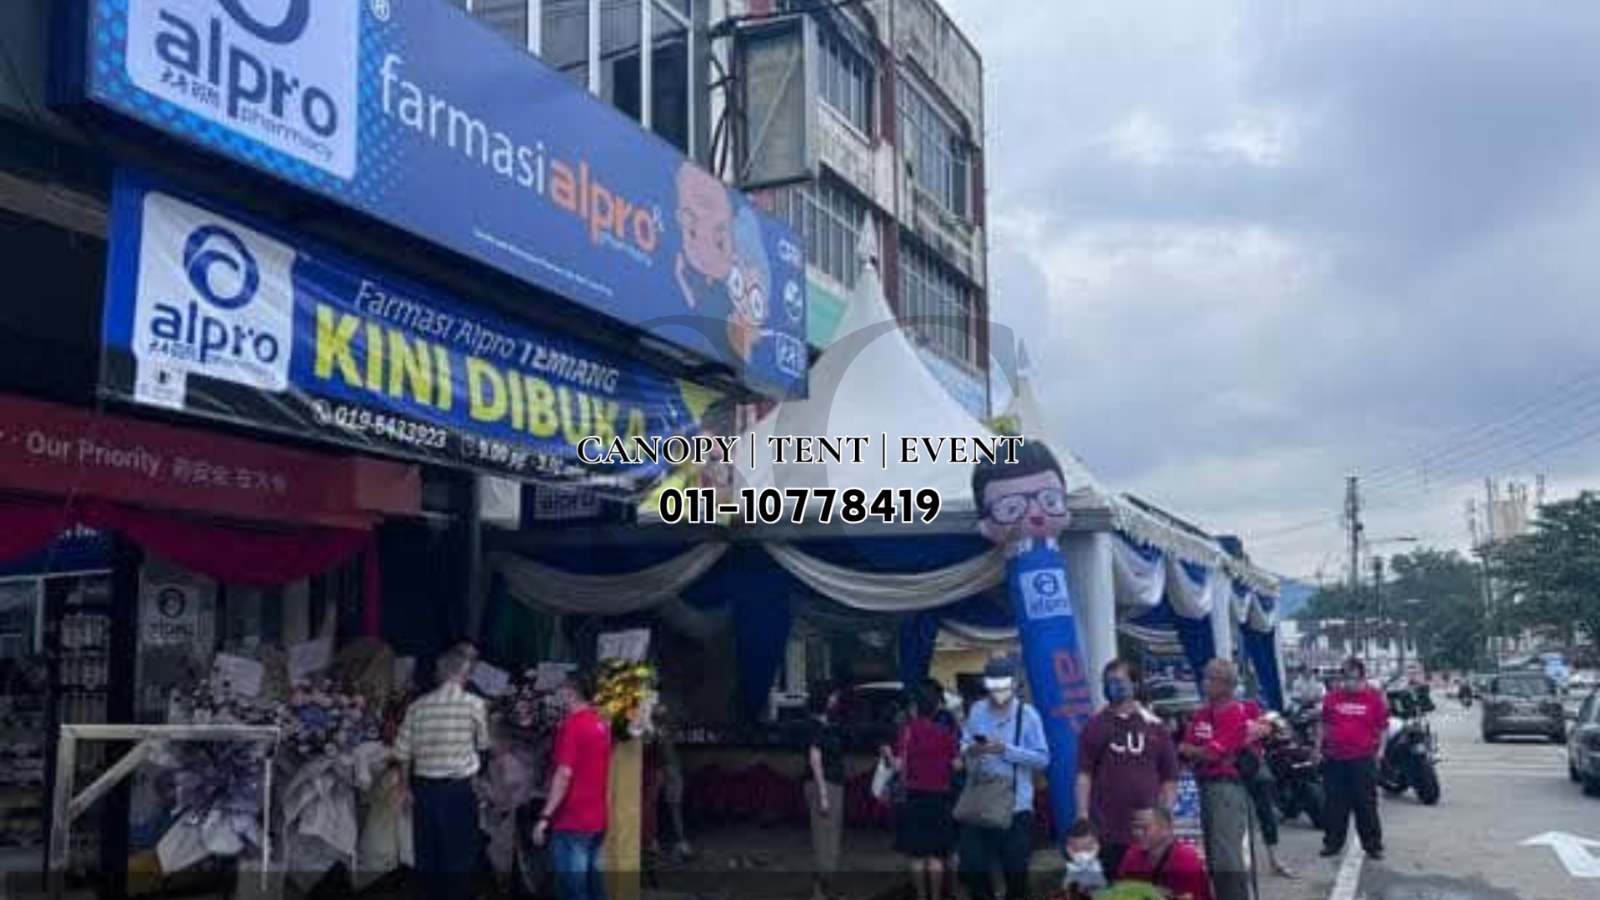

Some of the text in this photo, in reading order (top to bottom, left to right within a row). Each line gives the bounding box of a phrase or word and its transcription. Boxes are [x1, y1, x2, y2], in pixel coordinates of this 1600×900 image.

[155, 9, 338, 138] alpro
[380, 54, 657, 252] farmasi alpro
[151, 300, 279, 364] alpro
[314, 303, 648, 459] KINI DIBUKA
[354, 279, 620, 395] Farmasi Alpro TEMIANG
[26, 430, 71, 464] Our
[78, 438, 161, 478] Priority
